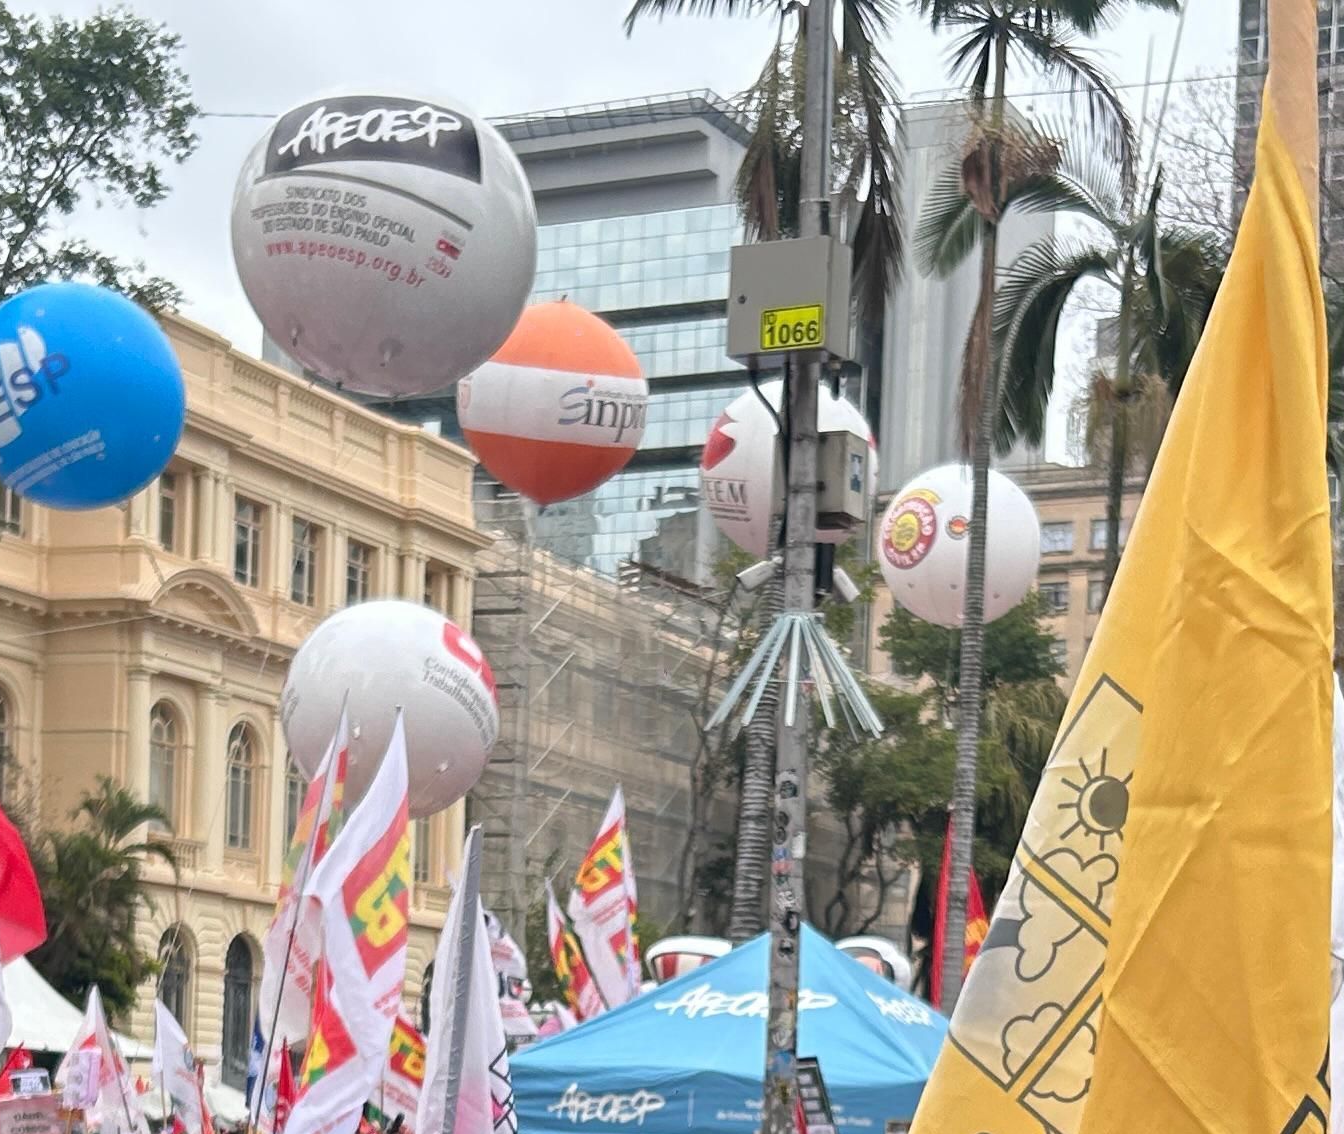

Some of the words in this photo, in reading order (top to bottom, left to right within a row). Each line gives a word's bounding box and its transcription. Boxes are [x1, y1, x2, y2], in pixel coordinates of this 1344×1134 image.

[278, 105, 462, 157] APEOESP
[286, 186, 342, 203] SINDICATO
[344, 189, 367, 206] DOS
[313, 204, 327, 216] DO
[330, 204, 371, 225] ENSINO
[373, 215, 416, 243] OFICIAL
[315, 219, 331, 233] DE
[333, 216, 352, 237] SÃO
[354, 229, 390, 247] PAULO
[265, 239, 425, 287] www.apeoesp.org.br
[766, 321, 817, 345] 1066
[547, 1082, 666, 1126] APEOESP
